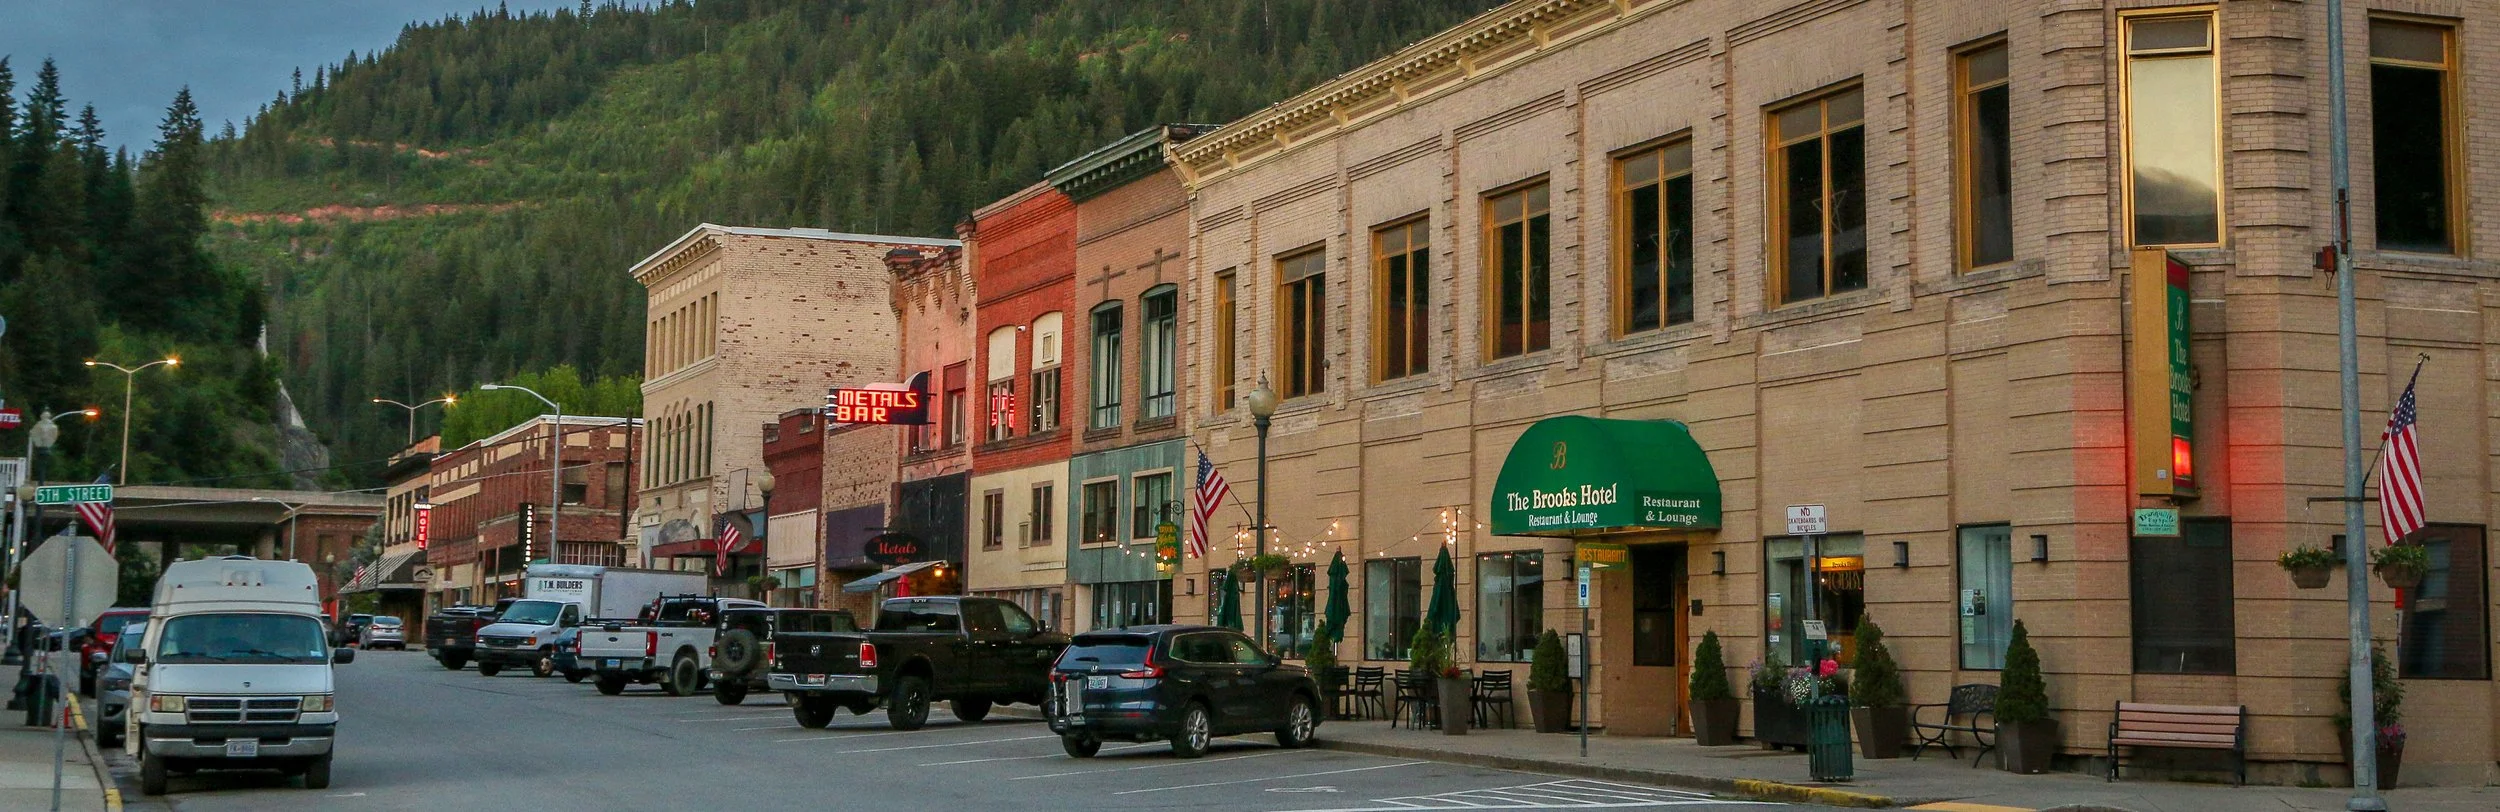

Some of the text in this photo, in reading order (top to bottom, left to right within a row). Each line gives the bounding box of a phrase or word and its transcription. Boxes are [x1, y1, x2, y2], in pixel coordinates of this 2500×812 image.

[2174, 338, 2187, 365] The
[2169, 364, 2191, 396] Brooks
[838, 390, 917, 408] METALS
[837, 406, 887, 422] BAR
[2172, 395, 2191, 424] Hotel
[1550, 441, 1567, 470] B
[38, 486, 109, 502] 5TH STREET
[1507, 482, 1617, 512] The Brooks Hotel
[1643, 495, 1701, 509] Restaurant
[1528, 510, 1598, 527] Restaurant & Lounge
[1645, 511, 1698, 526] & Lounge
[1800, 507, 1811, 517] NO
[418, 510, 427, 548] HOTEL
[879, 541, 917, 554] Metals
[1579, 547, 1626, 563] RESTAURANT
[557, 580, 583, 589] BUILDERS
